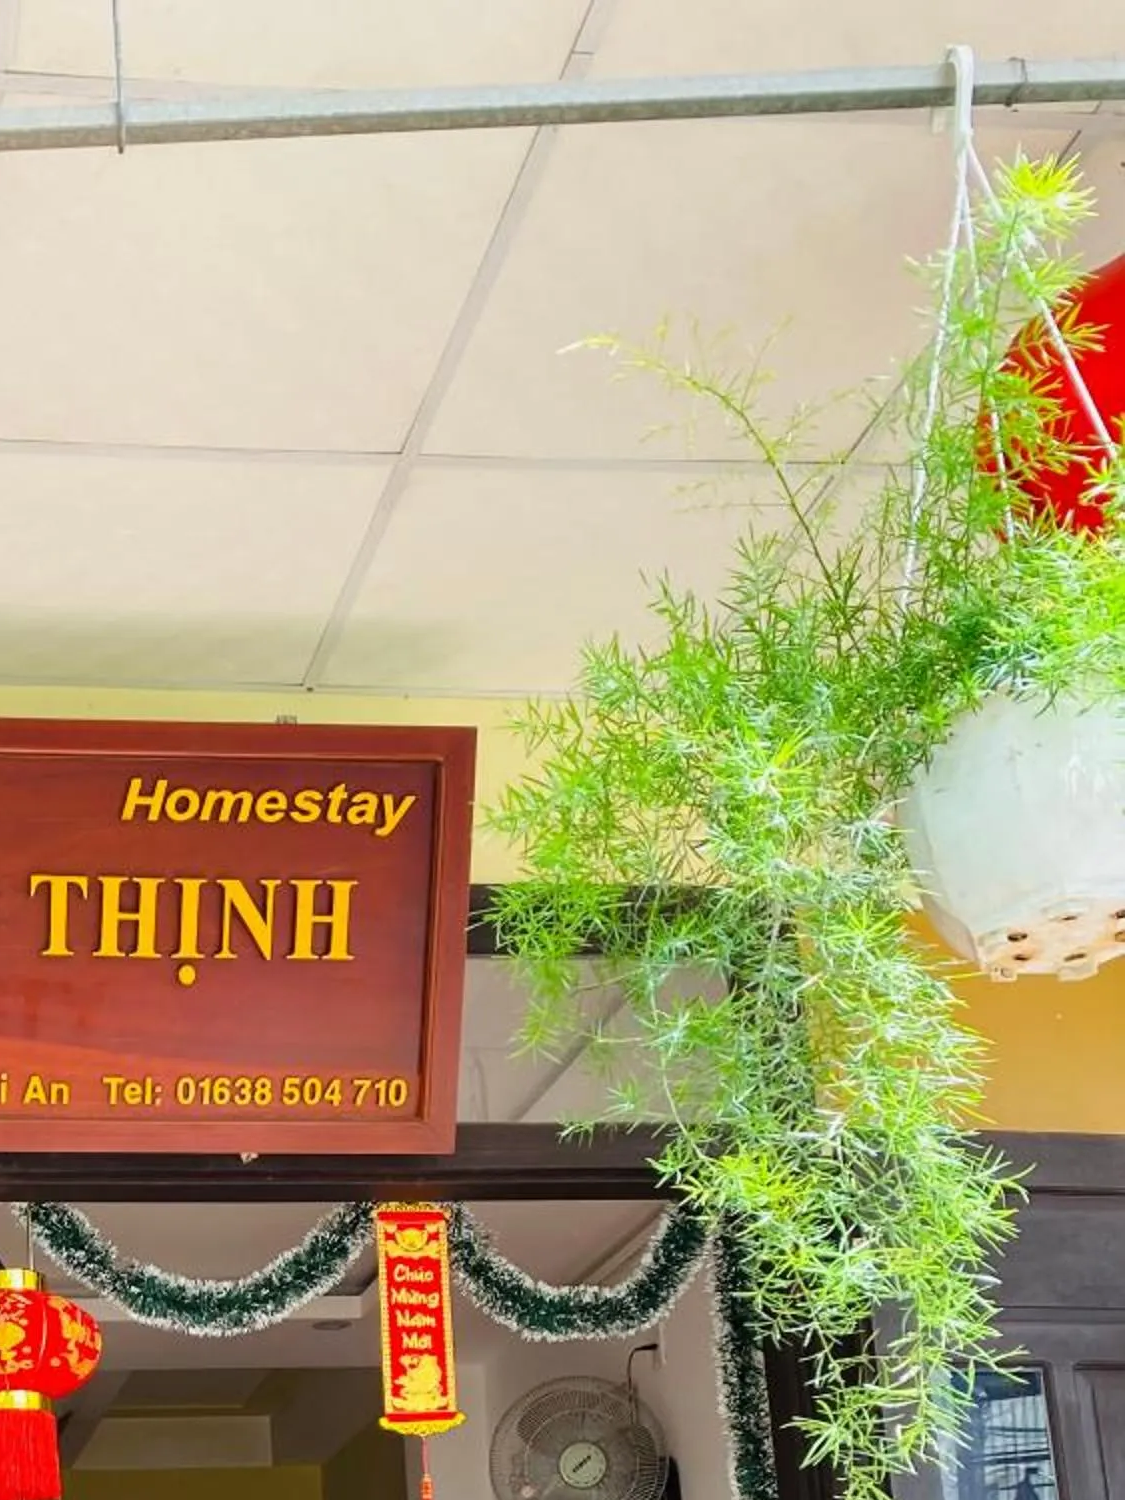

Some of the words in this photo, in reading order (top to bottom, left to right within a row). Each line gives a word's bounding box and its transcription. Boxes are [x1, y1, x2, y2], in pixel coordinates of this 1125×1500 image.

[121, 778, 416, 837] Homestay
[30, 874, 360, 986] THỊNH
[22, 1076, 70, 1105] An
[103, 1076, 163, 1106] Tel:
[177, 1076, 273, 1106] 01638
[282, 1077, 343, 1107] 504
[353, 1078, 408, 1108] 710
